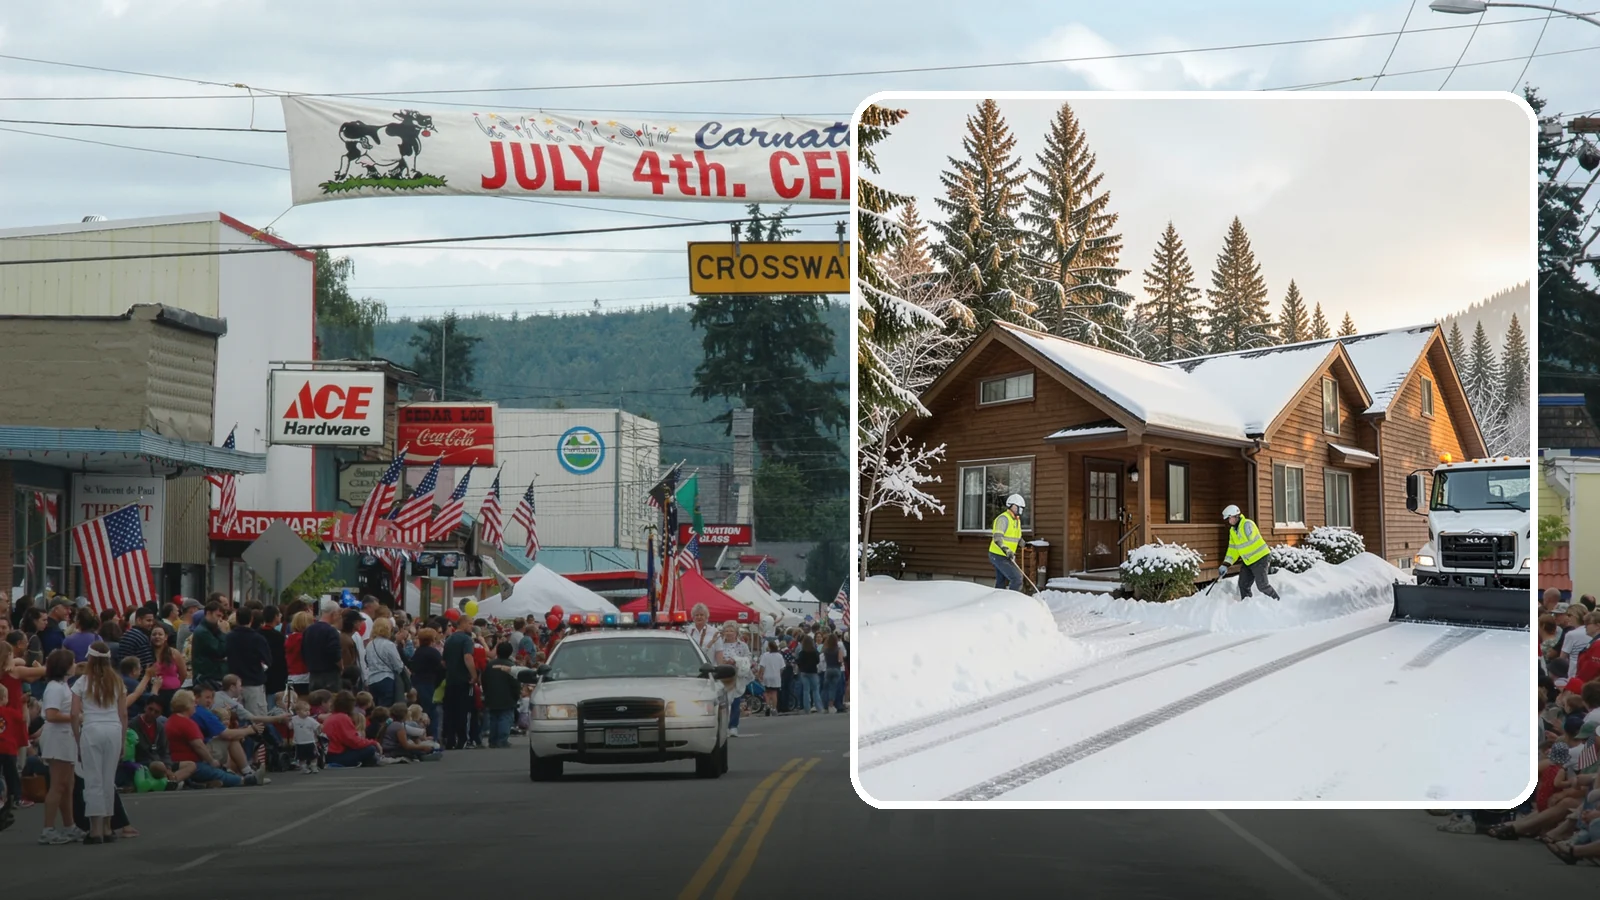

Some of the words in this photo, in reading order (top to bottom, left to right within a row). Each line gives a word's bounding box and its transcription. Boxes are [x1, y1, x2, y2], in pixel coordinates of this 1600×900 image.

[481, 141, 604, 192] JULY
[632, 150, 746, 197] 4th.
[697, 255, 850, 279] CROSSWA
[283, 380, 373, 420] ACE
[406, 409, 452, 422] CEDAR
[284, 421, 370, 436] Hardware
[95, 486, 124, 495] Vincent
[126, 486, 135, 495] de
[138, 486, 155, 495] Paul
[688, 527, 741, 535] CRNATION
[699, 535, 730, 543] GLASS
